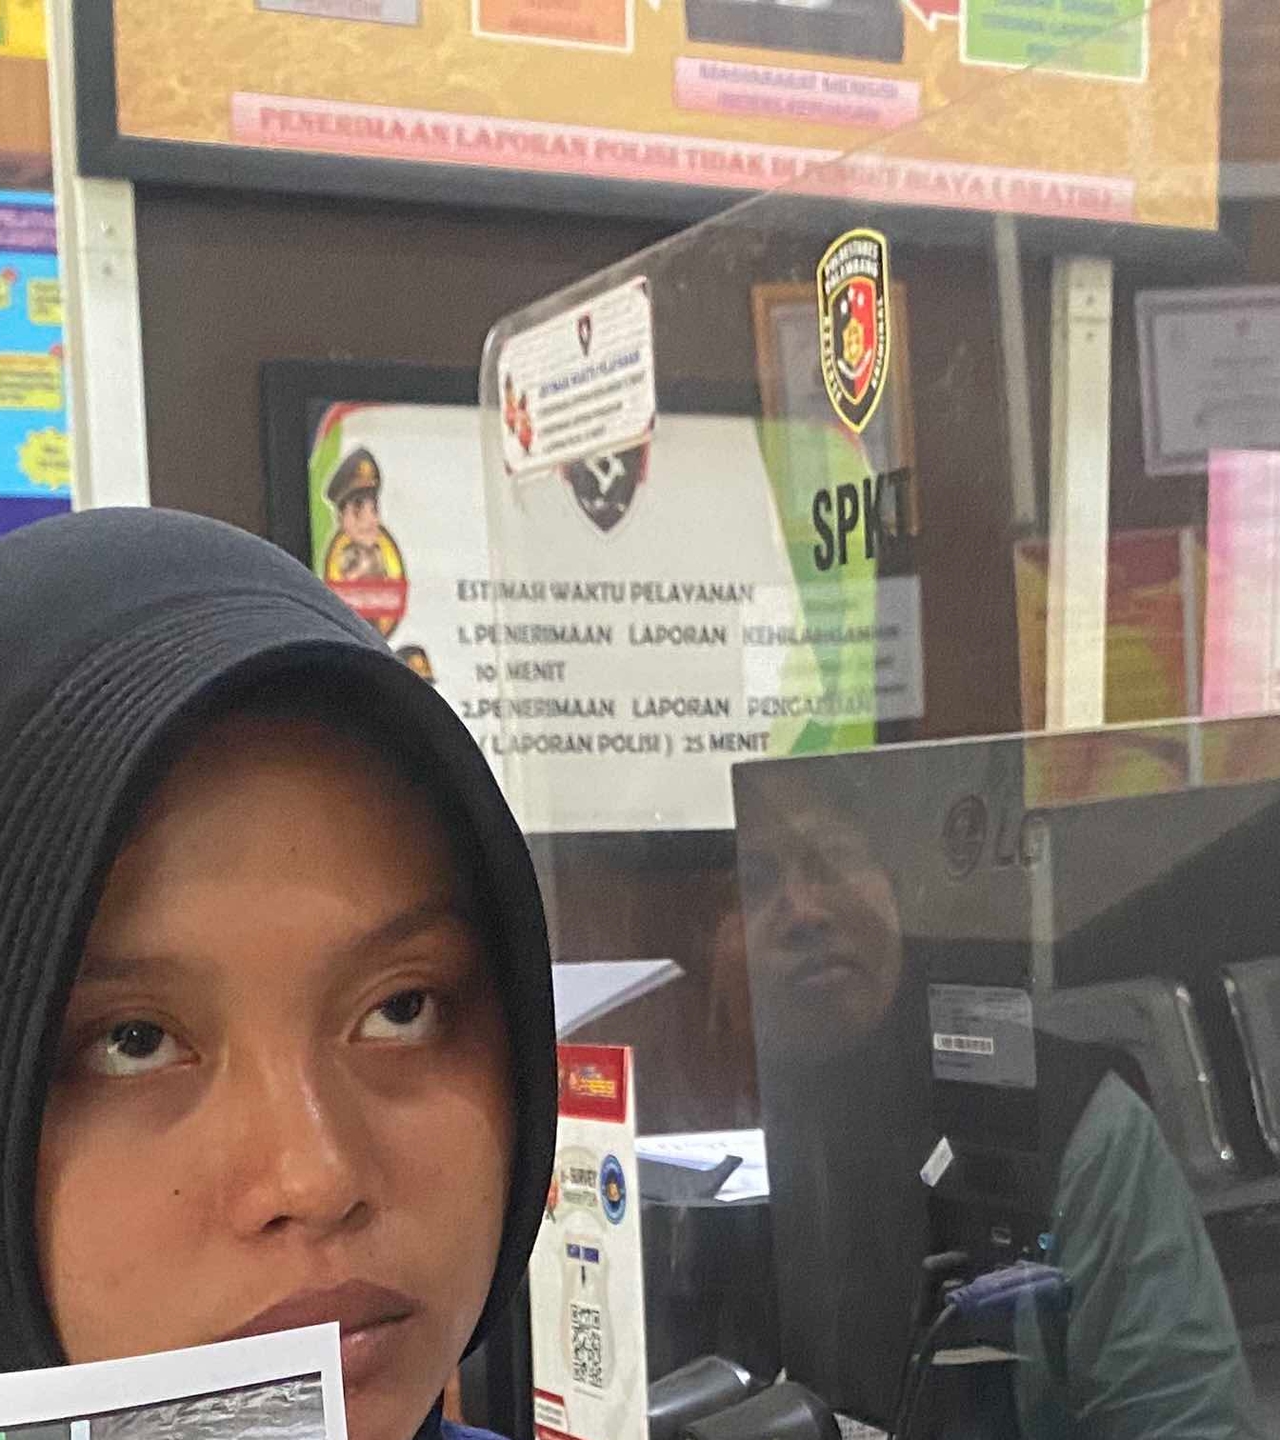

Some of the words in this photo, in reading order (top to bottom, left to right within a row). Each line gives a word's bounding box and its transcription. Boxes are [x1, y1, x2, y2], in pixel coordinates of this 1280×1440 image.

[812, 466, 912, 572] SPKT
[549, 580, 625, 602] WAKTU
[630, 579, 754, 604] PELAYANAN
[629, 623, 726, 645] LAPORAN
[476, 664, 497, 682] 10
[508, 660, 565, 683] MENIT
[632, 697, 730, 718] LAPORAN
[710, 731, 770, 754] MENIT
